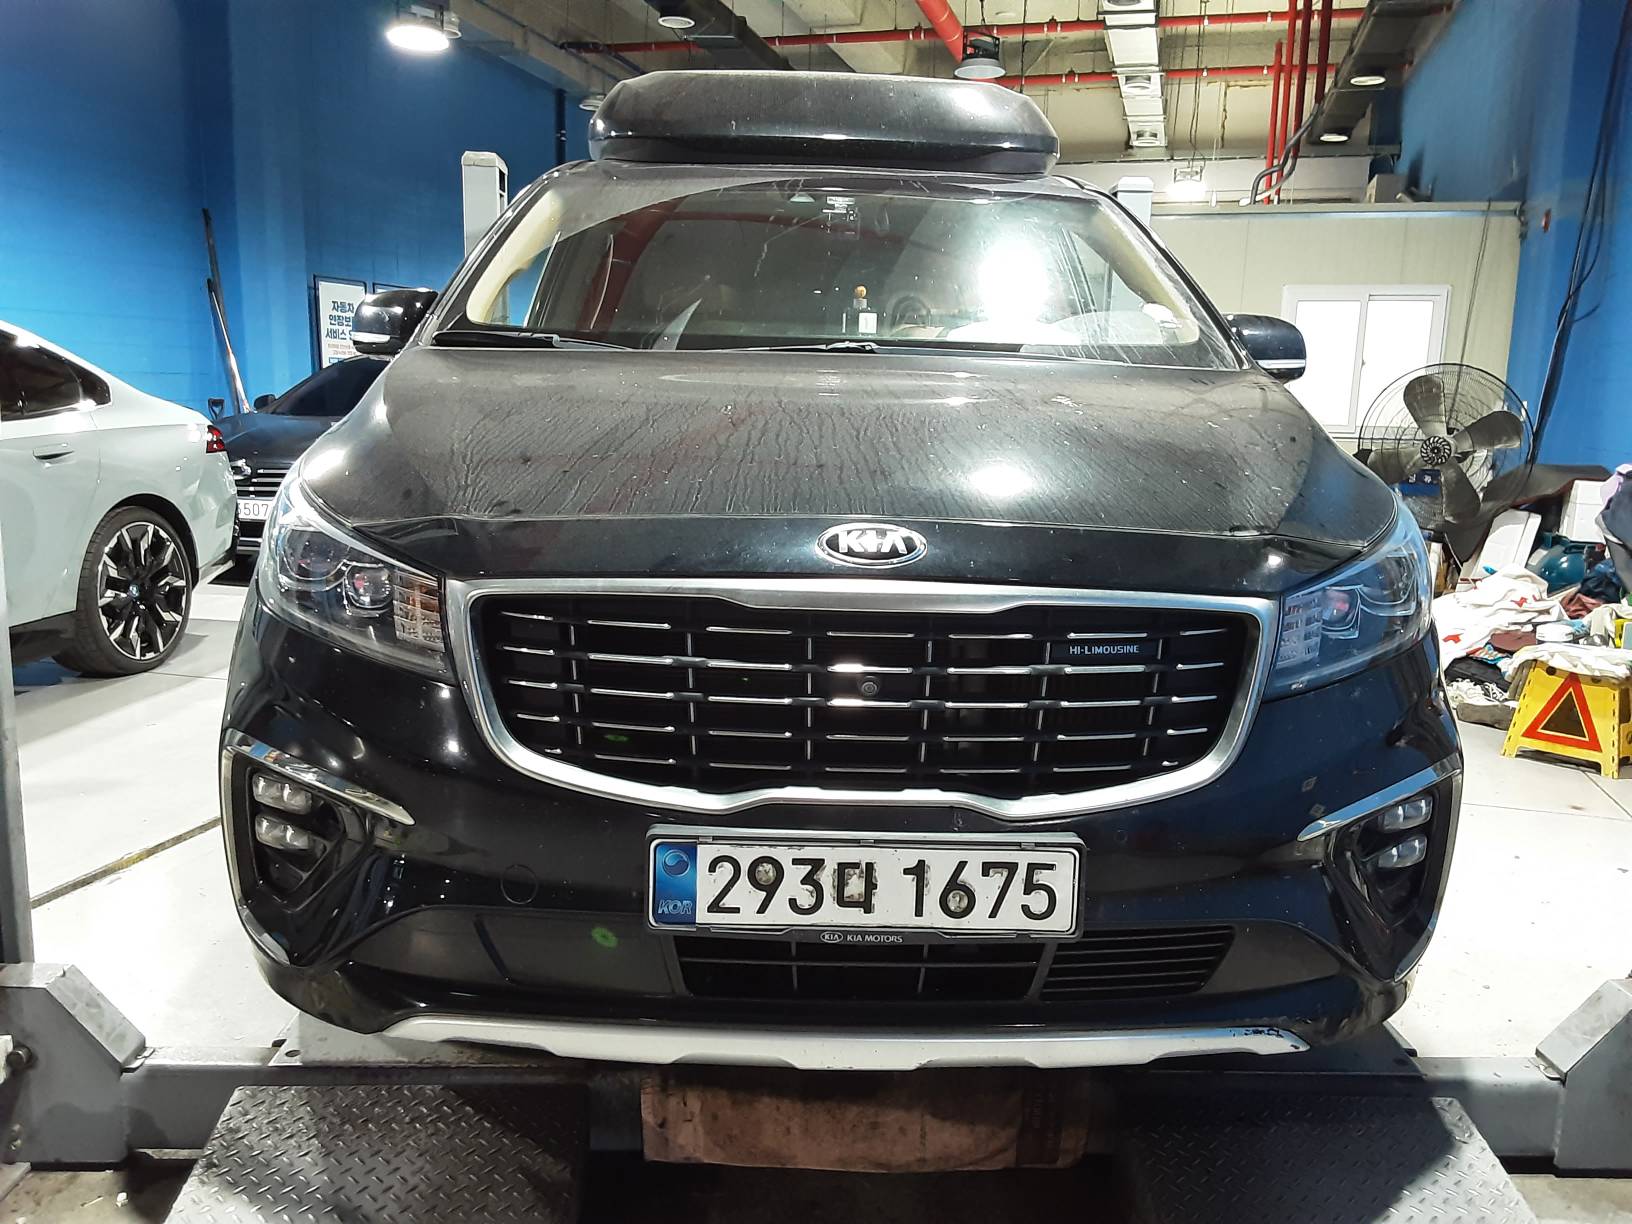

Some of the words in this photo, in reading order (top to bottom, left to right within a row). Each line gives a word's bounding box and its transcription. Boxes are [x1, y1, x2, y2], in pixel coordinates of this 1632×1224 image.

[331, 300, 354, 313] 자동차
[329, 315, 352, 327] 연장보
[325, 328, 347, 340] 서비스
[838, 529, 907, 554] KIA
[1069, 645, 1139, 654] HI-LIMOUSINE
[903, 859, 1057, 920] 1675
[657, 900, 692, 914] KOR
[847, 934, 863, 942] KIA
[865, 934, 903, 943] MOTORS
